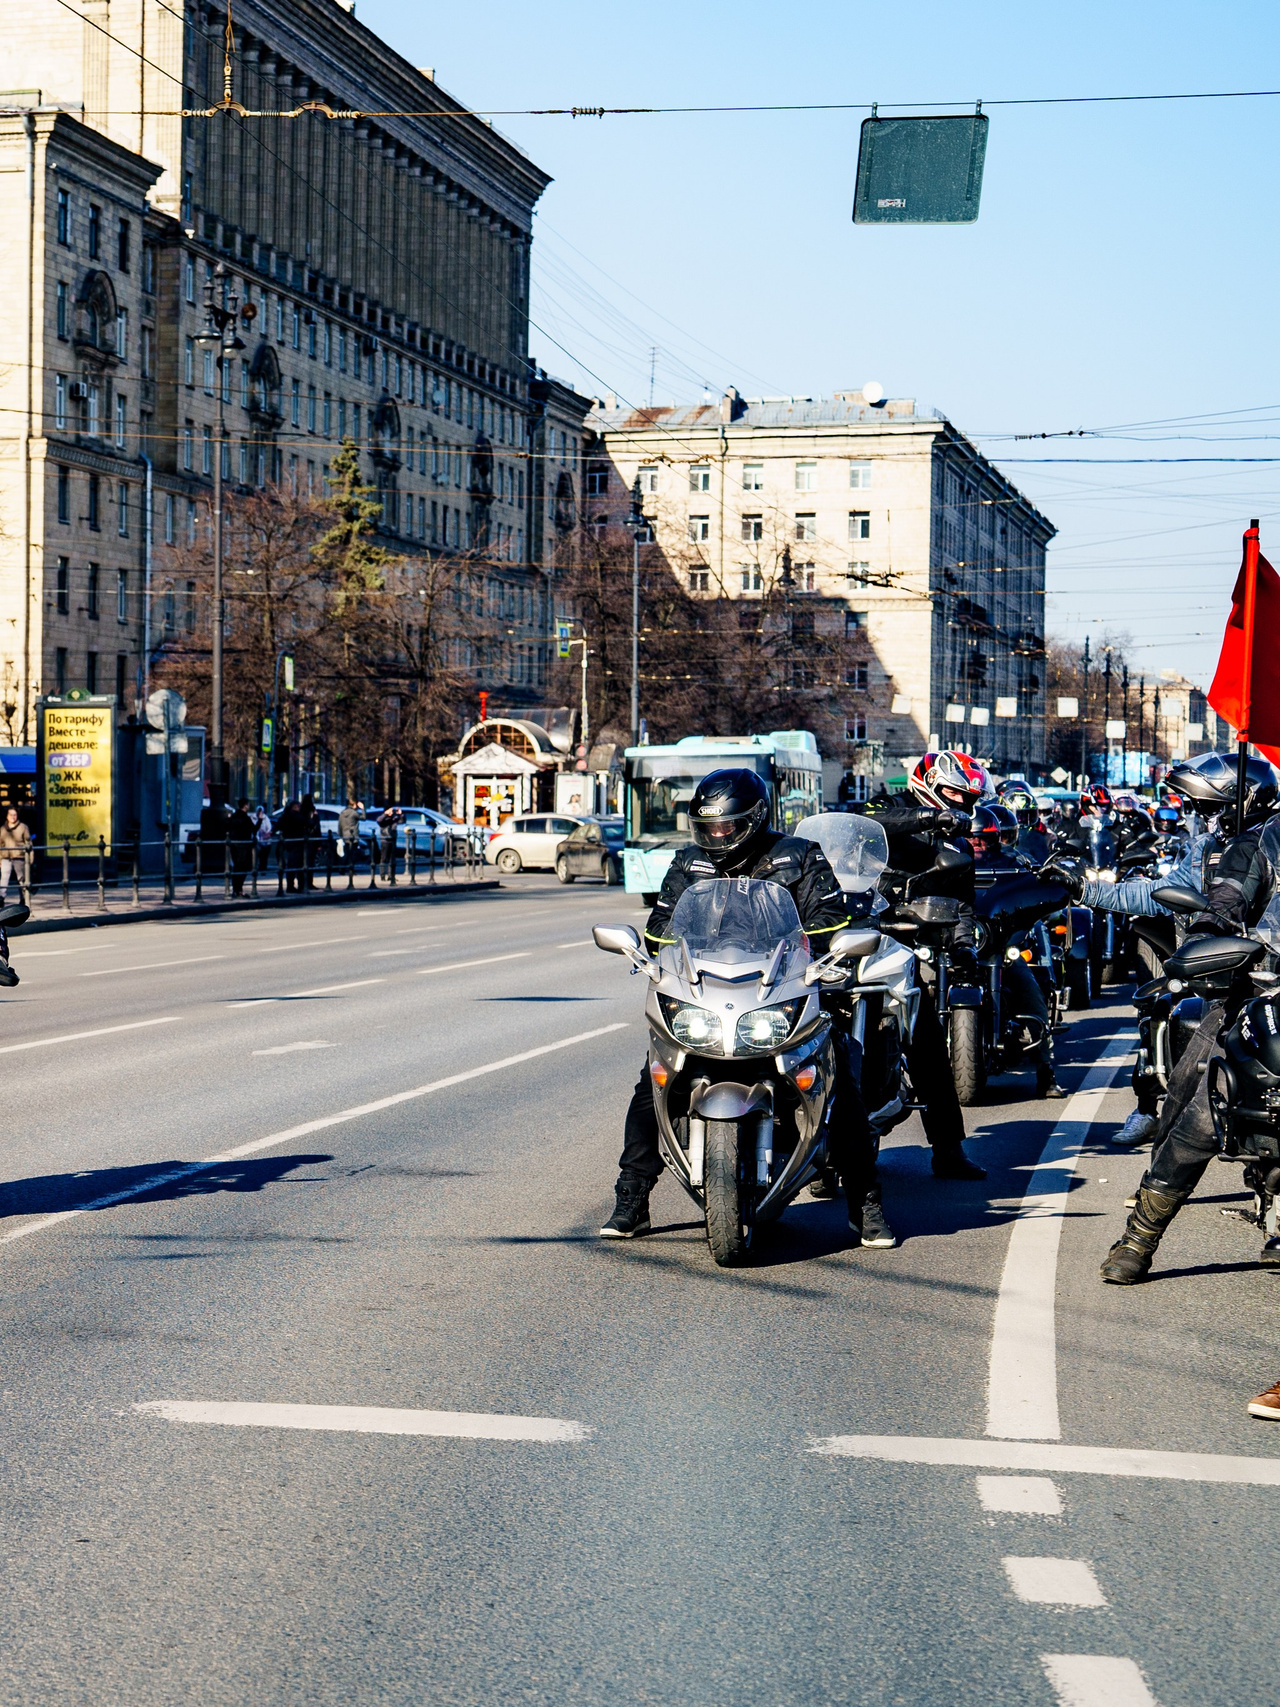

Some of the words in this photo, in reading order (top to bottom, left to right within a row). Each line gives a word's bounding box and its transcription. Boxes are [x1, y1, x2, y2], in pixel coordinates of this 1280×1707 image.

[49, 714, 62, 724] По
[65, 714, 105, 726] тарифу
[49, 727, 86, 737] Вместе
[49, 742, 98, 751] дешевле:
[51, 757, 63, 767] от
[49, 773, 62, 783] до
[64, 771, 82, 781] ЖК
[49, 783, 100, 794] «Зелёный
[49, 799, 97, 810] квартал»
